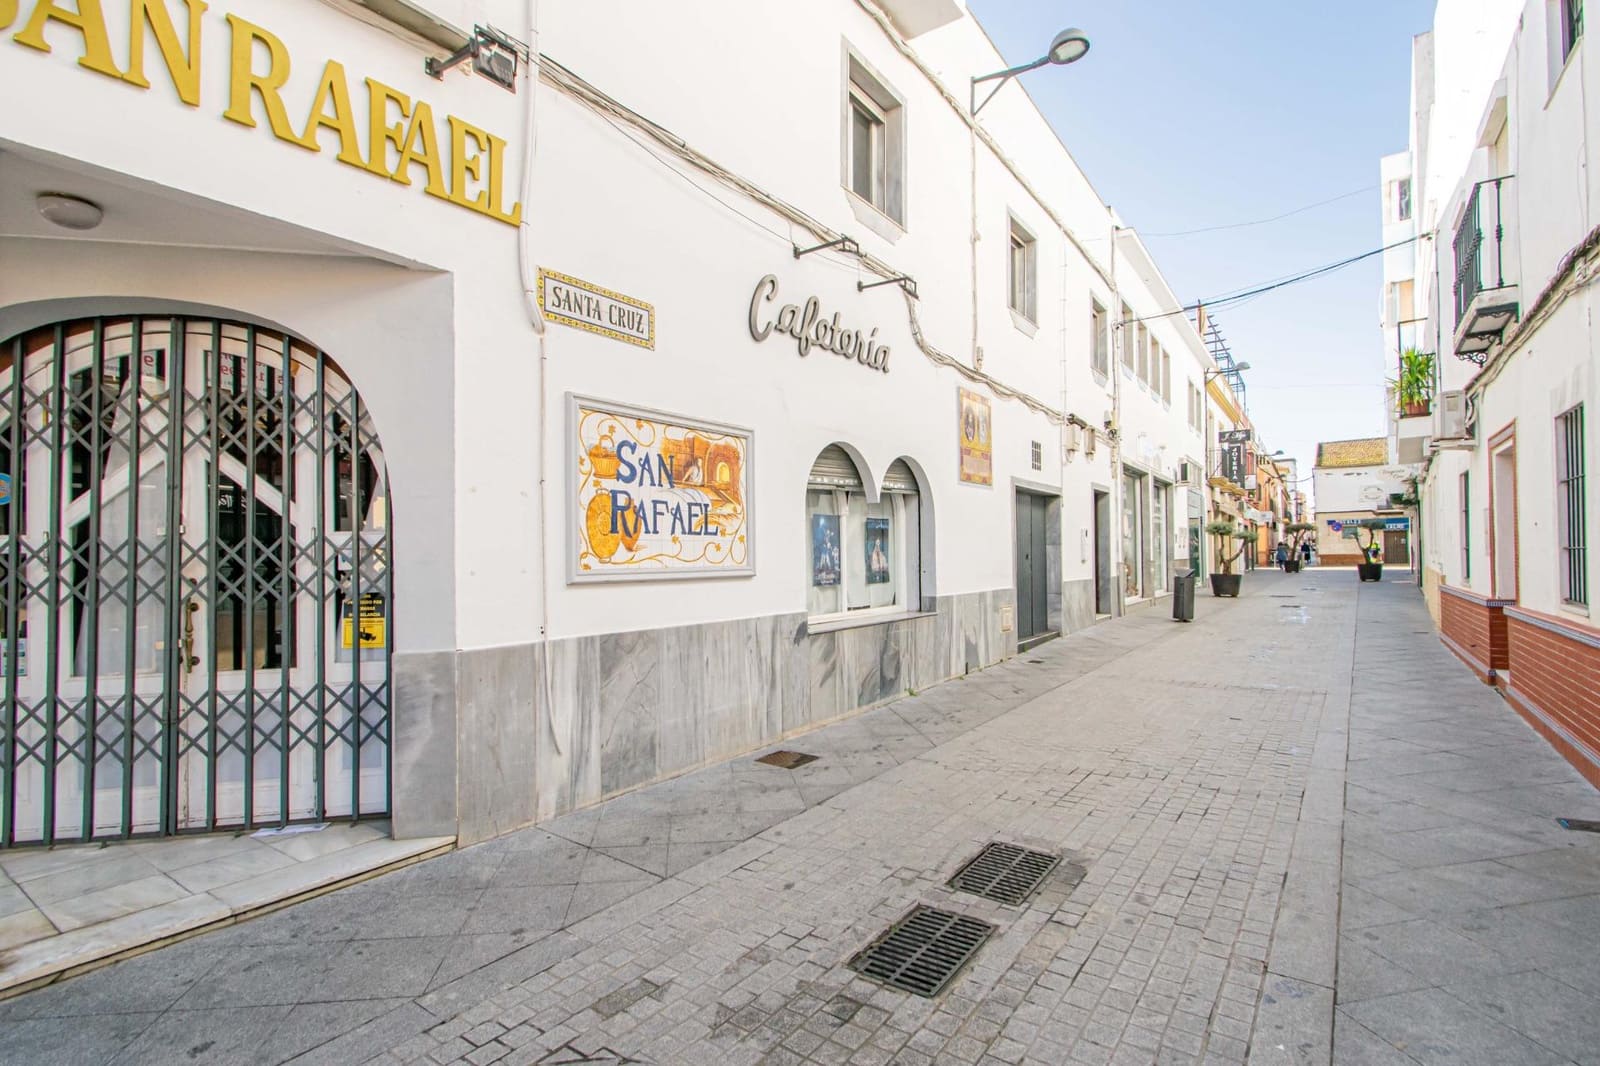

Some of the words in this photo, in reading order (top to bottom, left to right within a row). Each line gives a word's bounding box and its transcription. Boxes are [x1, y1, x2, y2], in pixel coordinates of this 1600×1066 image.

[0, 0, 207, 107] AN
[223, 13, 522, 227] RAFAEL
[552, 286, 602, 323] SANTA
[608, 306, 645, 335] CRUZ
[748, 274, 891, 373] Cafetería
[615, 440, 675, 489] SAN
[609, 489, 719, 538] RAFAEL
